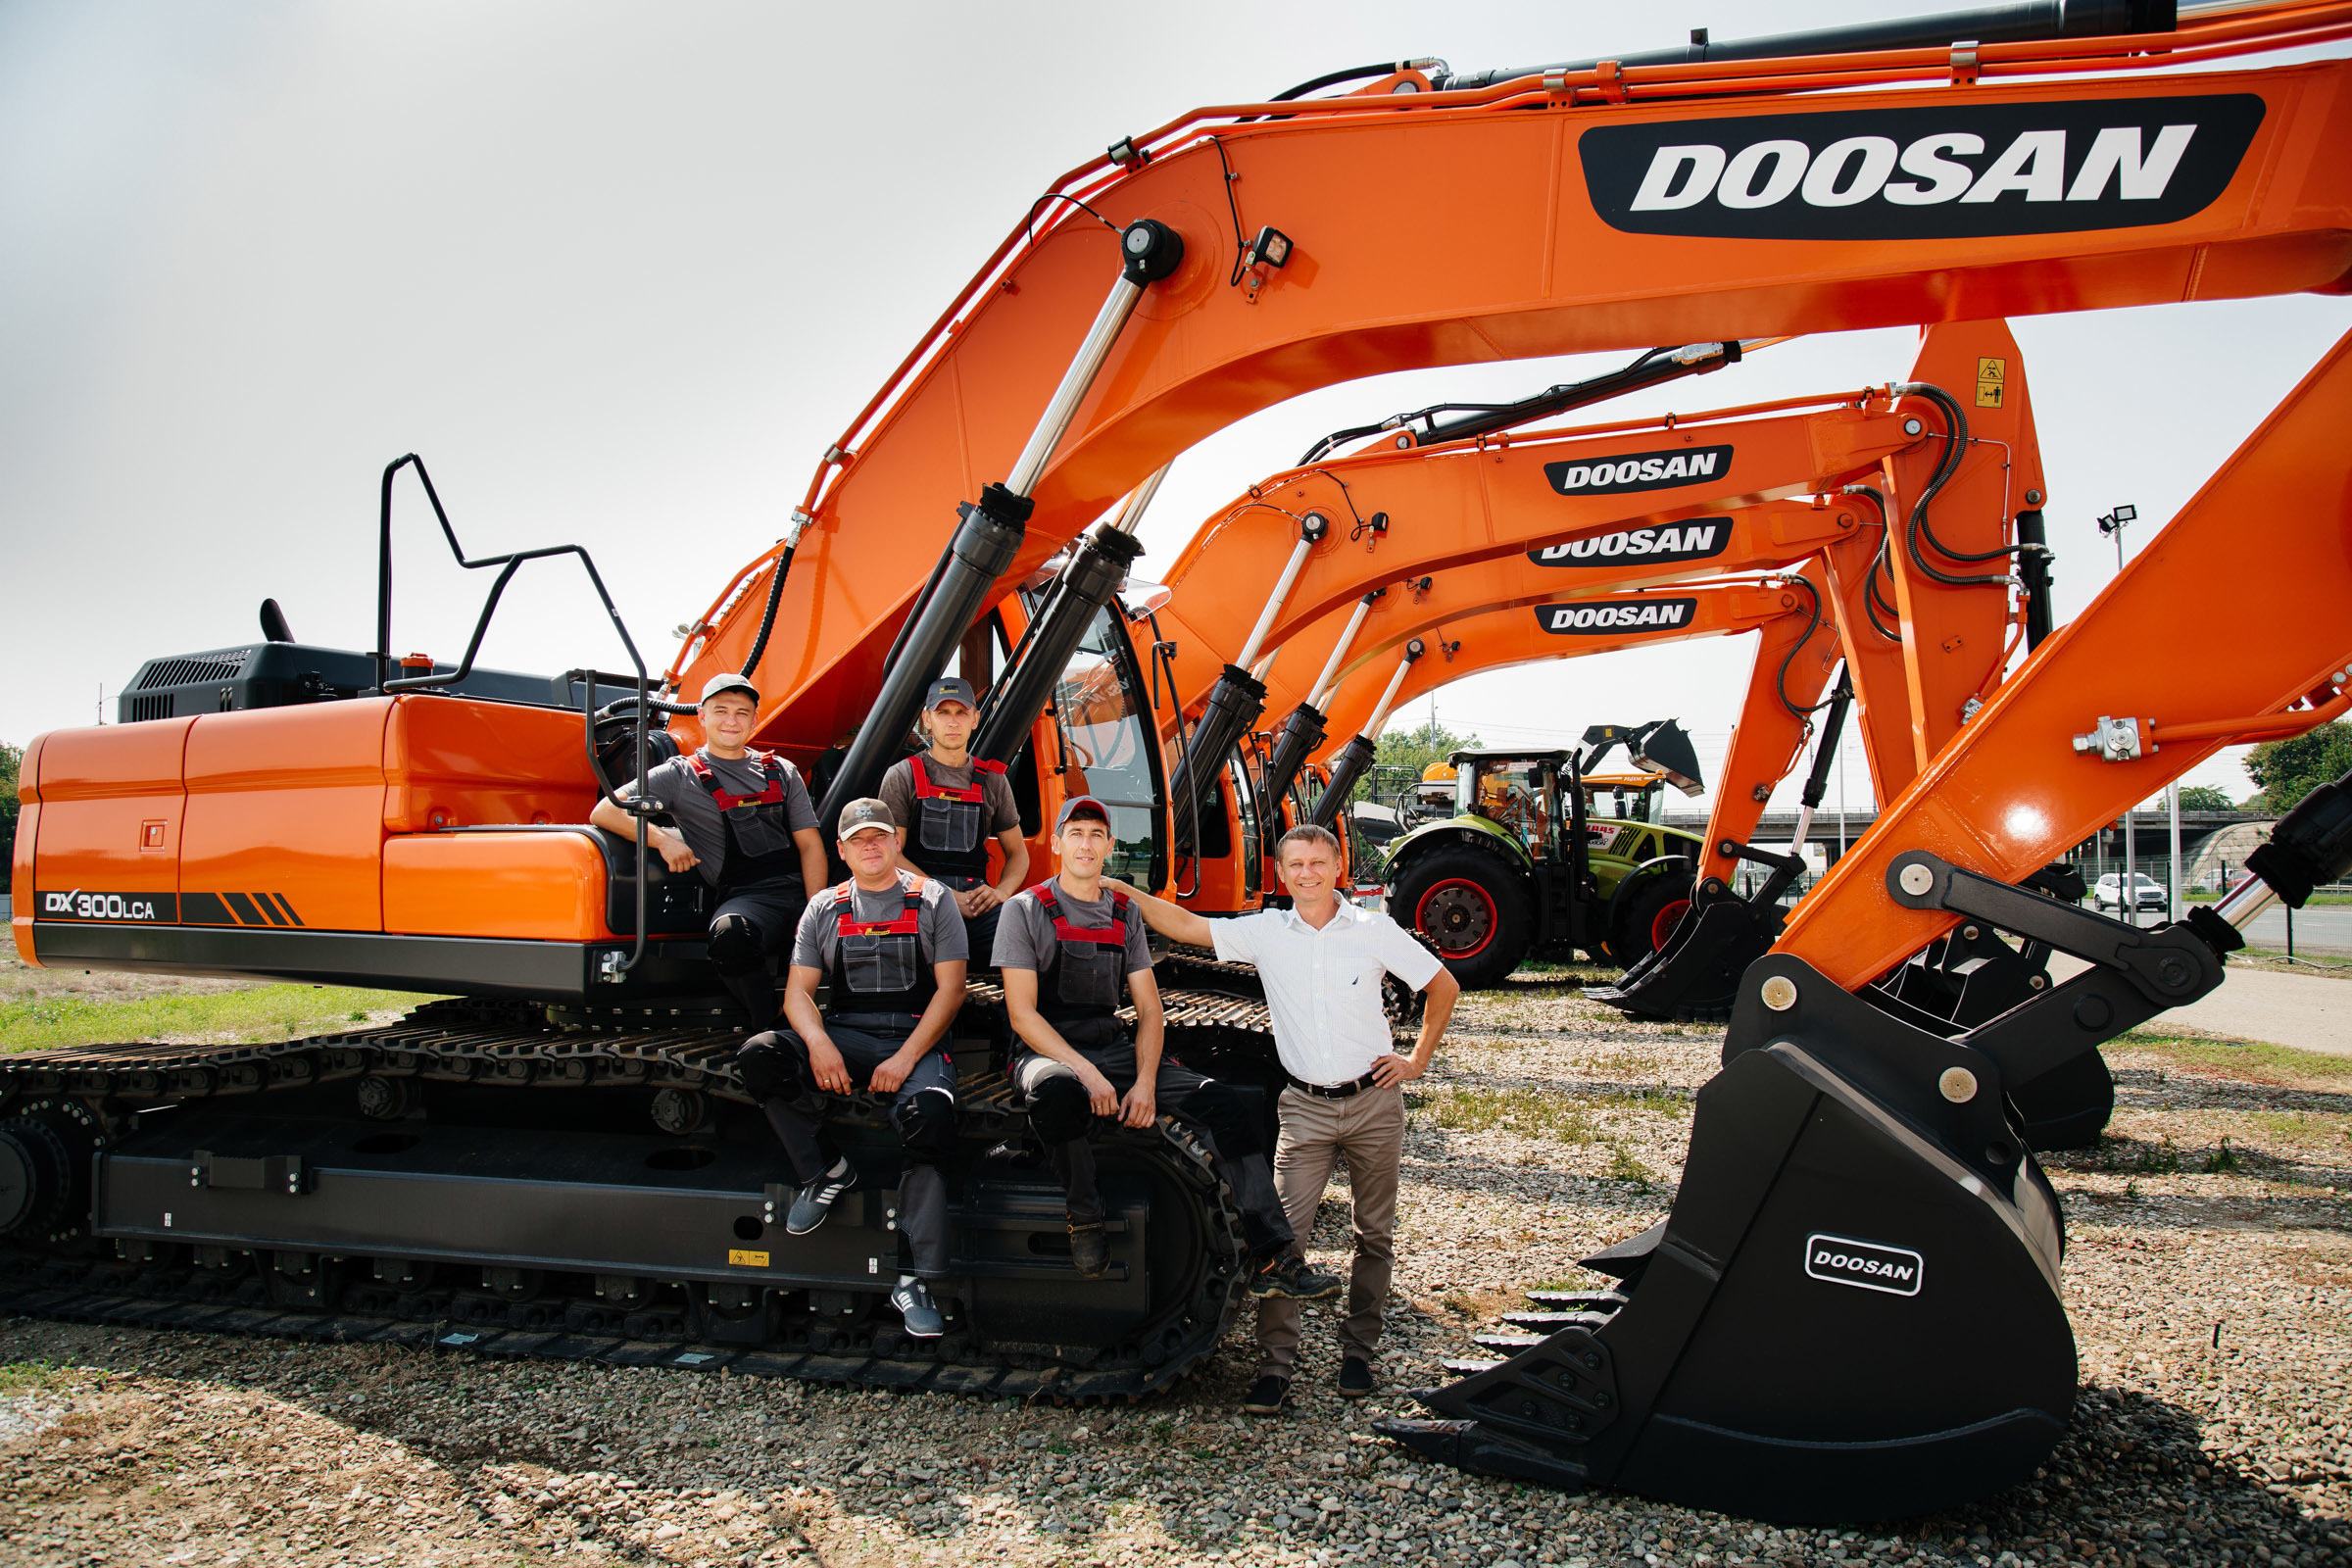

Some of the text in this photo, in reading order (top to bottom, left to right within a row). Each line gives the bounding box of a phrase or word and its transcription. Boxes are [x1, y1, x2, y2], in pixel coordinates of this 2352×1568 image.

[1629, 123, 2198, 212] DOOSAN
[1563, 452, 1718, 490] DOOSAN
[1550, 604, 1685, 629] DOOSAN
[1587, 824, 1616, 835] LAAS
[1814, 1250, 1914, 1281] DOOSAN
